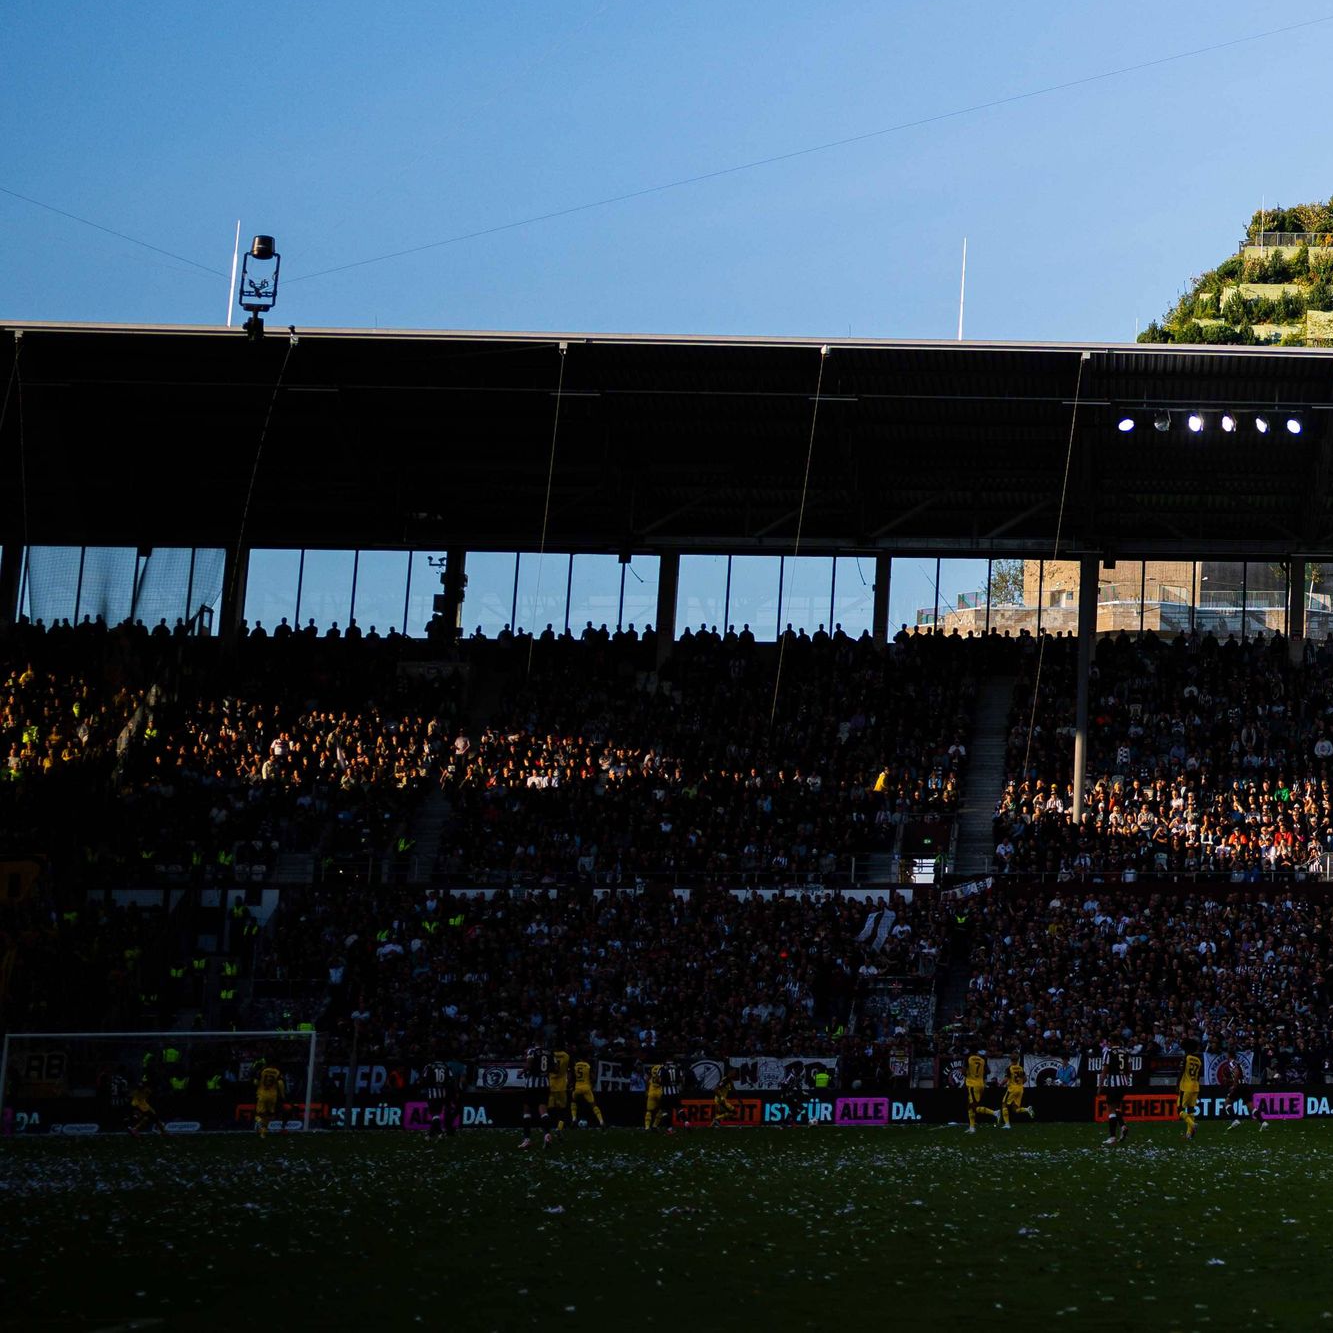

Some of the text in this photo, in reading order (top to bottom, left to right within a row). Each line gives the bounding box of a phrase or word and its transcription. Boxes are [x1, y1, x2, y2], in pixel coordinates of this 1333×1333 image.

[540, 1055, 548, 1072] 8
[1118, 1054, 1125, 1070] 5
[434, 1068, 446, 1083] 16
[668, 1068, 676, 1082] 11
[363, 1102, 402, 1126] FÜR
[462, 1106, 494, 1125] DA.
[840, 1102, 885, 1120] ALLE
[892, 1102, 922, 1120] DA.
[1099, 1099, 1177, 1117] FEIHEIT
[1258, 1097, 1300, 1115] ALLE
